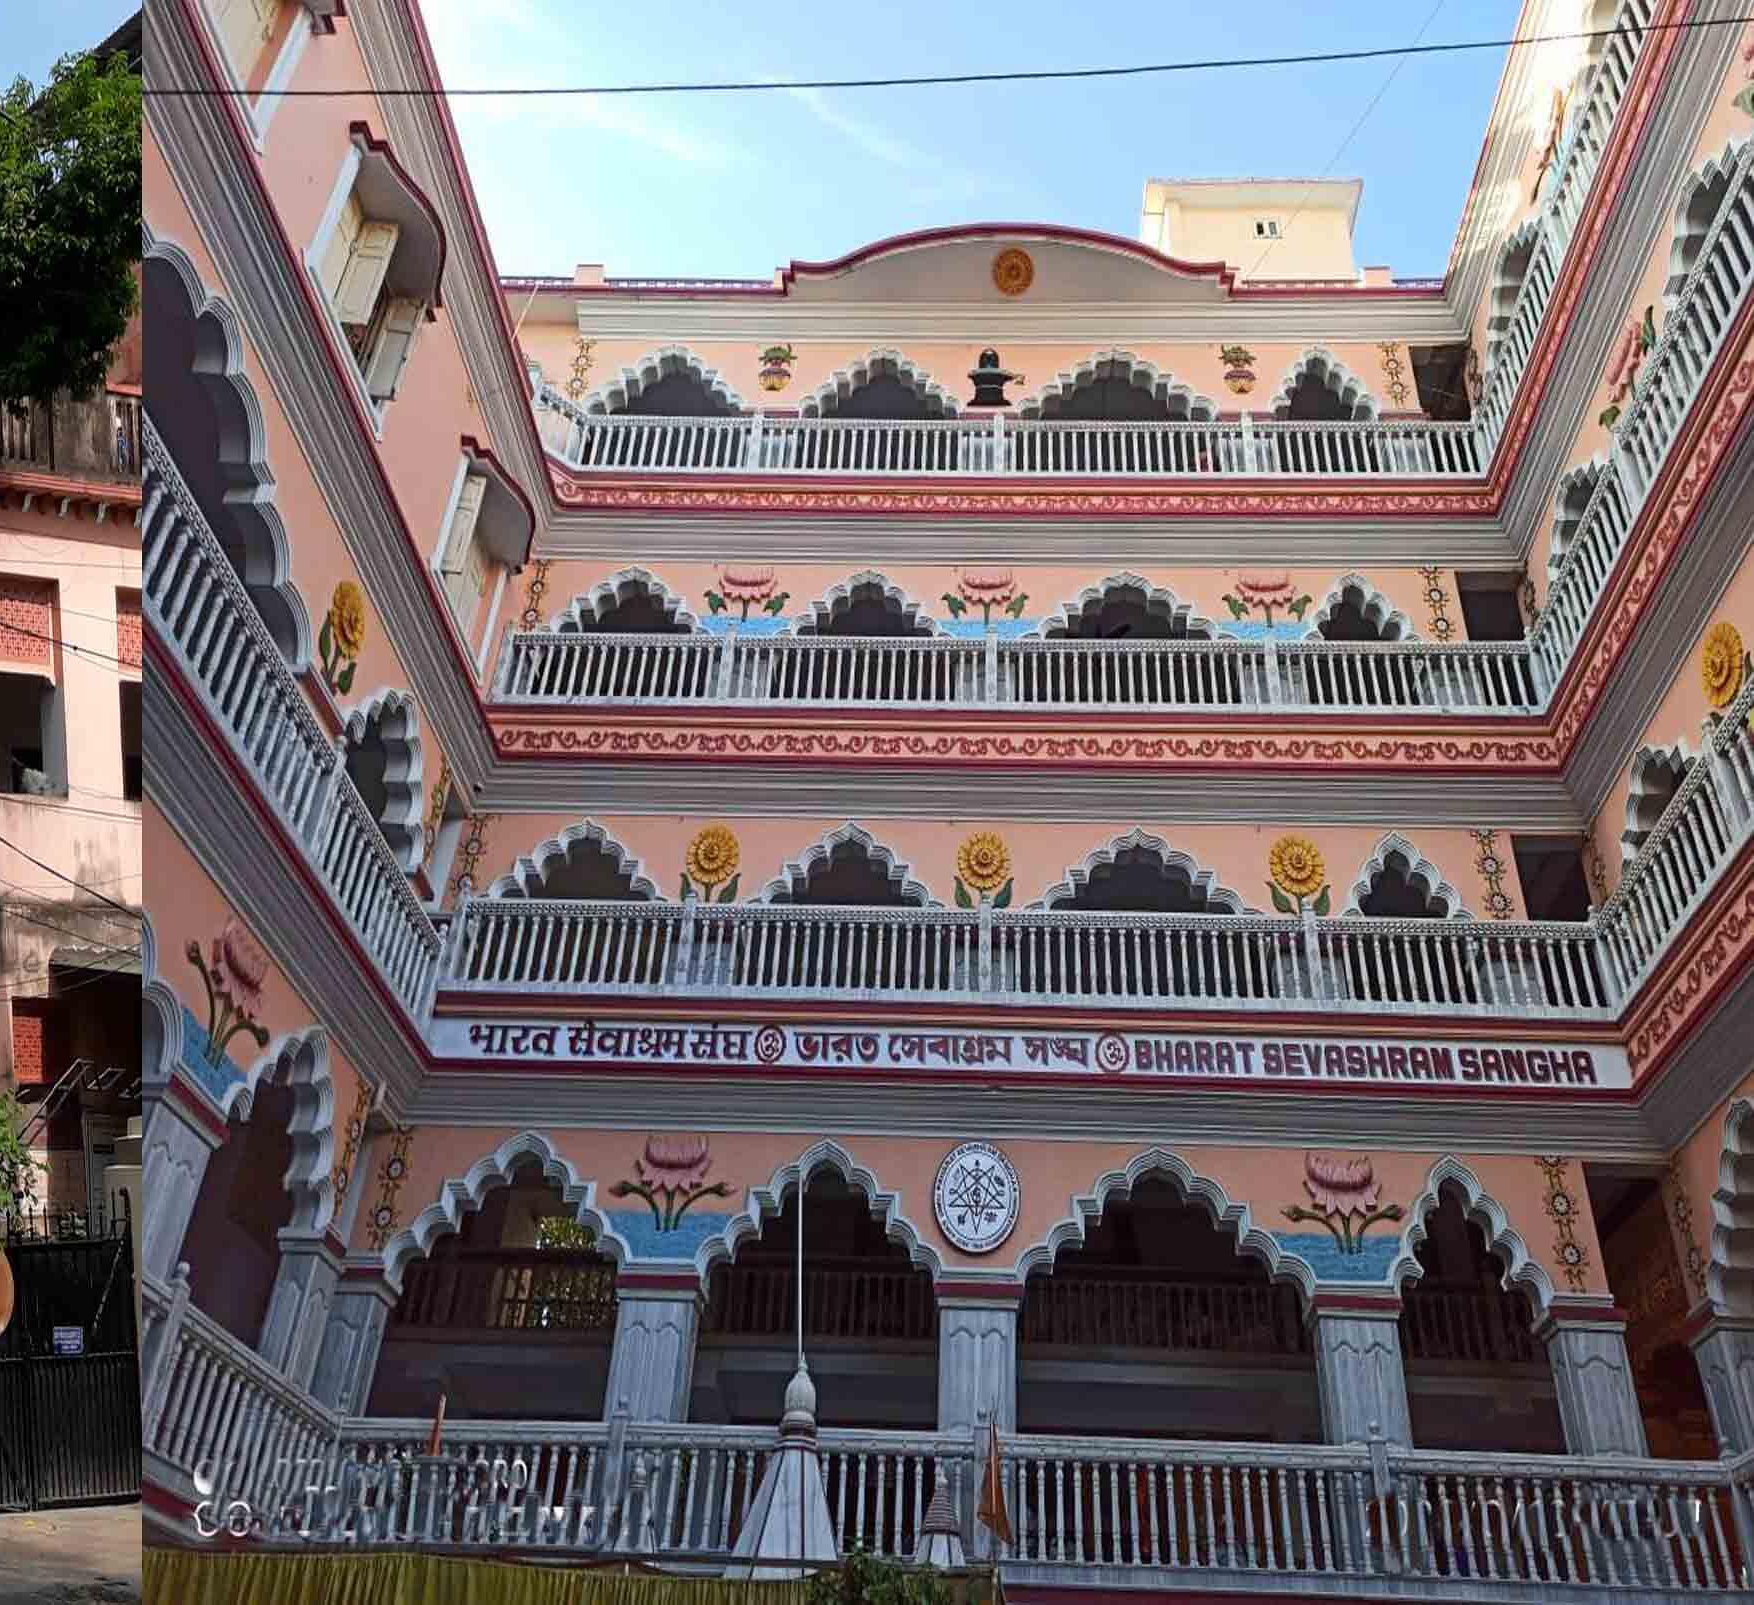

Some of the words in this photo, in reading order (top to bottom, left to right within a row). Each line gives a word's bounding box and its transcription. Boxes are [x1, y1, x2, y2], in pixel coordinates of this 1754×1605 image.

[469, 1025, 560, 1056] भारत
[566, 1018, 686, 1058] सेवाश्रम
[689, 1019, 752, 1059] संघ
[794, 1032, 881, 1063] ভারত
[888, 1033, 1014, 1065] সেবাশ্রম
[1134, 1039, 1255, 1074] BHARAT
[1261, 1043, 1456, 1080] SEVASHRAM
[1458, 1048, 1597, 1084] SANGHA
